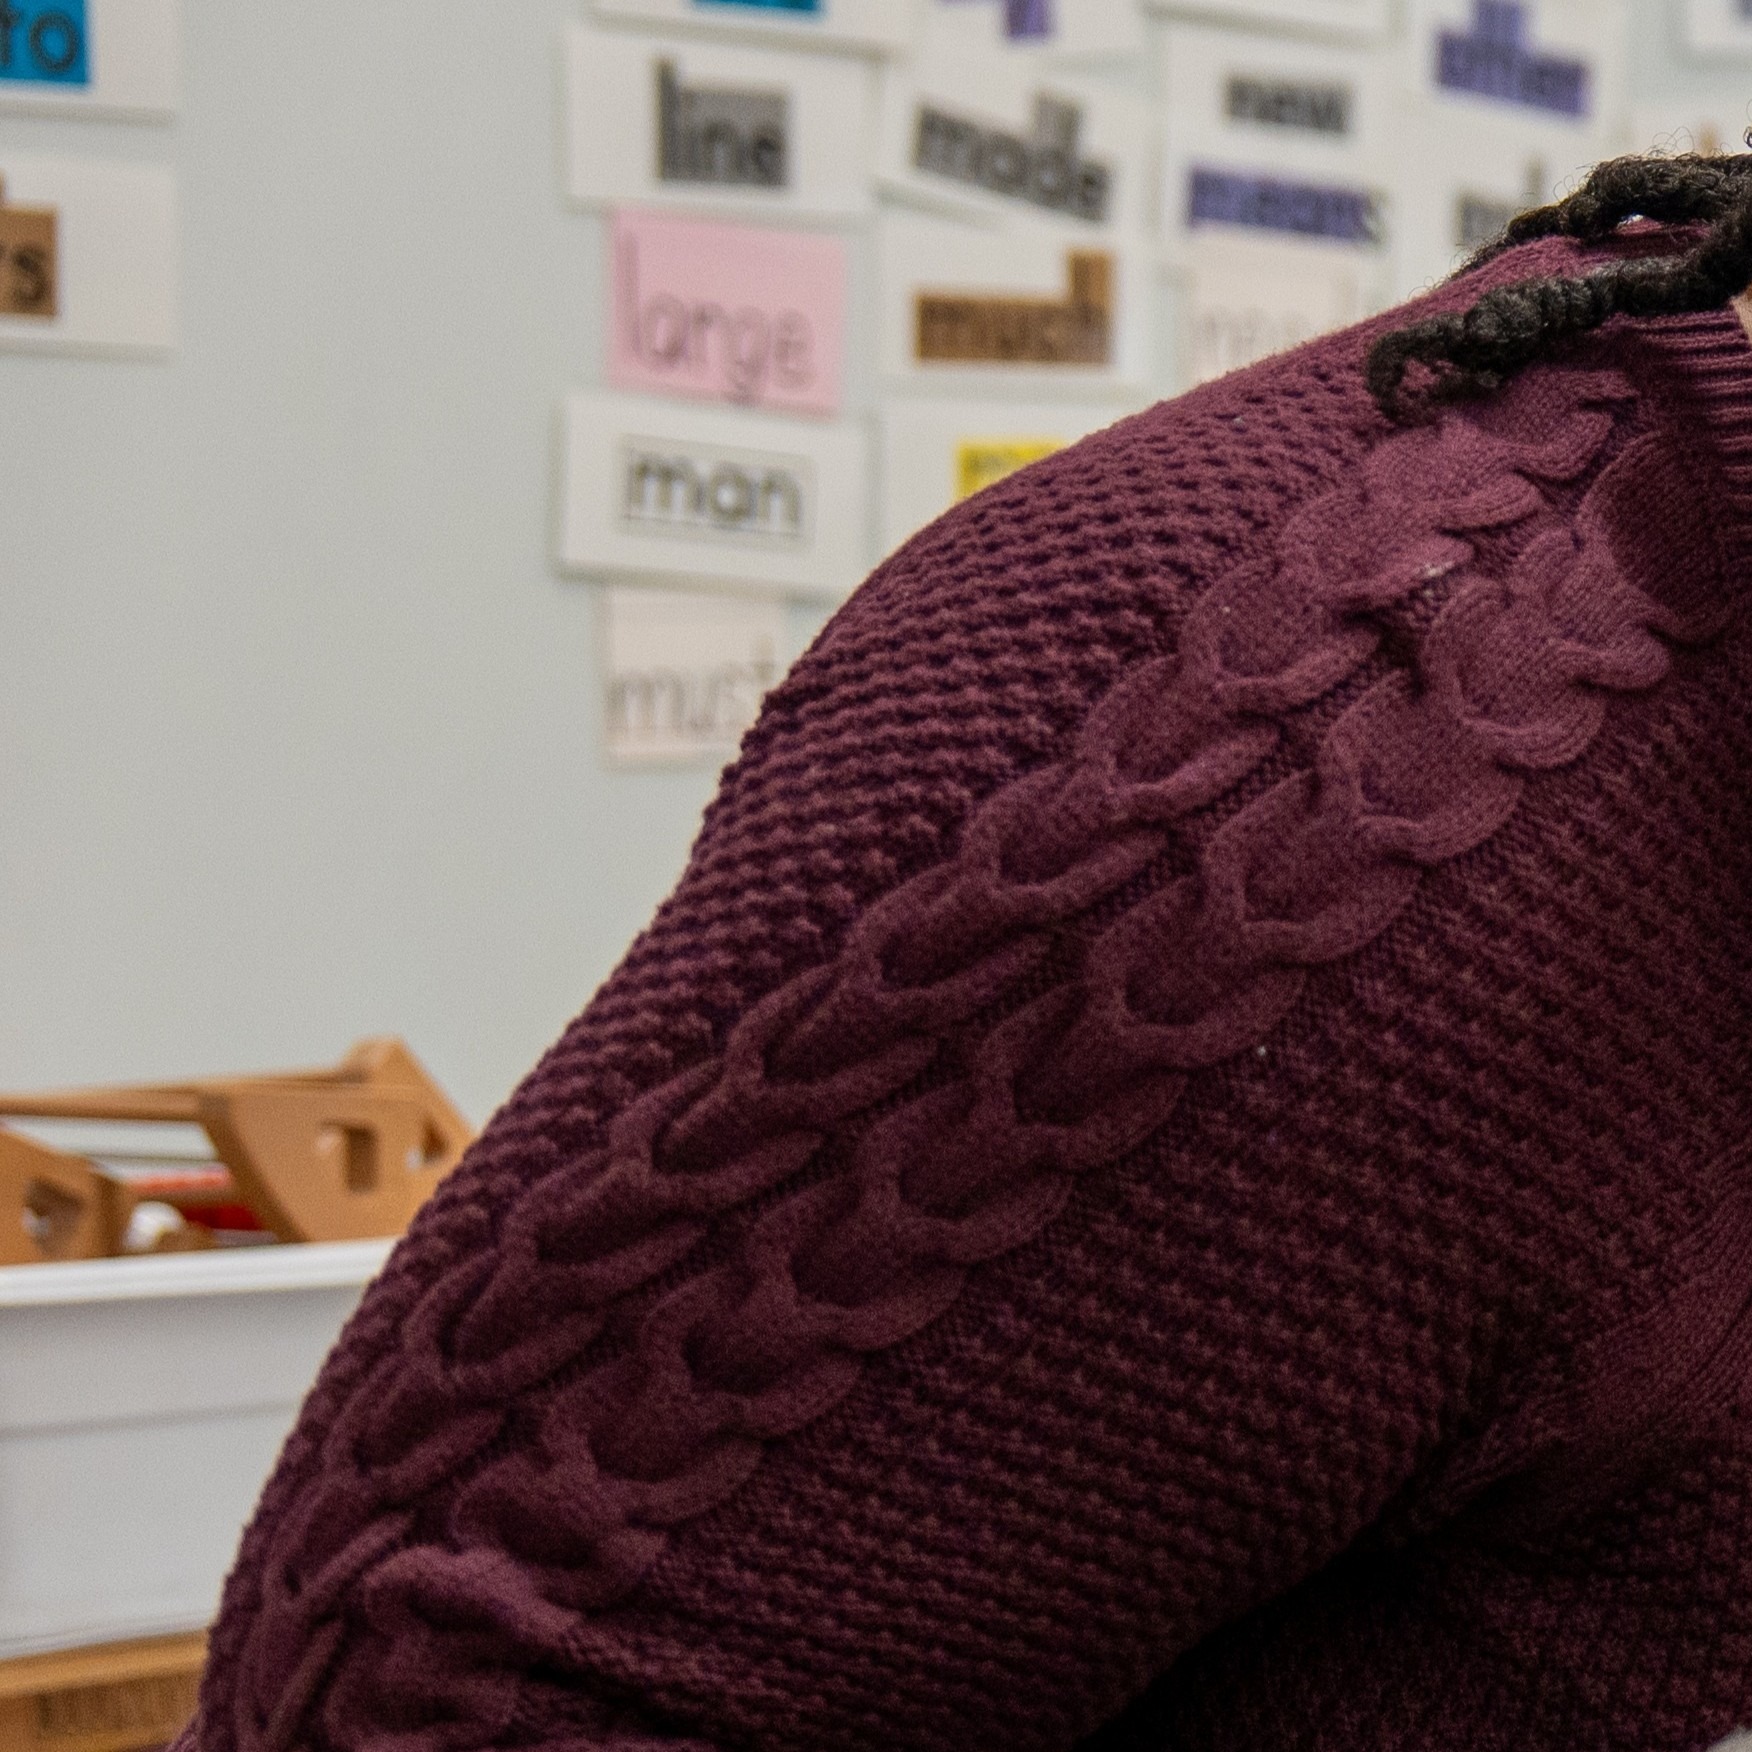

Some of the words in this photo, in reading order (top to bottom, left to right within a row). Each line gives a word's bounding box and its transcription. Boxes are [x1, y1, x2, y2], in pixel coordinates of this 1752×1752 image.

[655, 56, 787, 186] line
[617, 230, 814, 406] large
[628, 446, 803, 526] man
